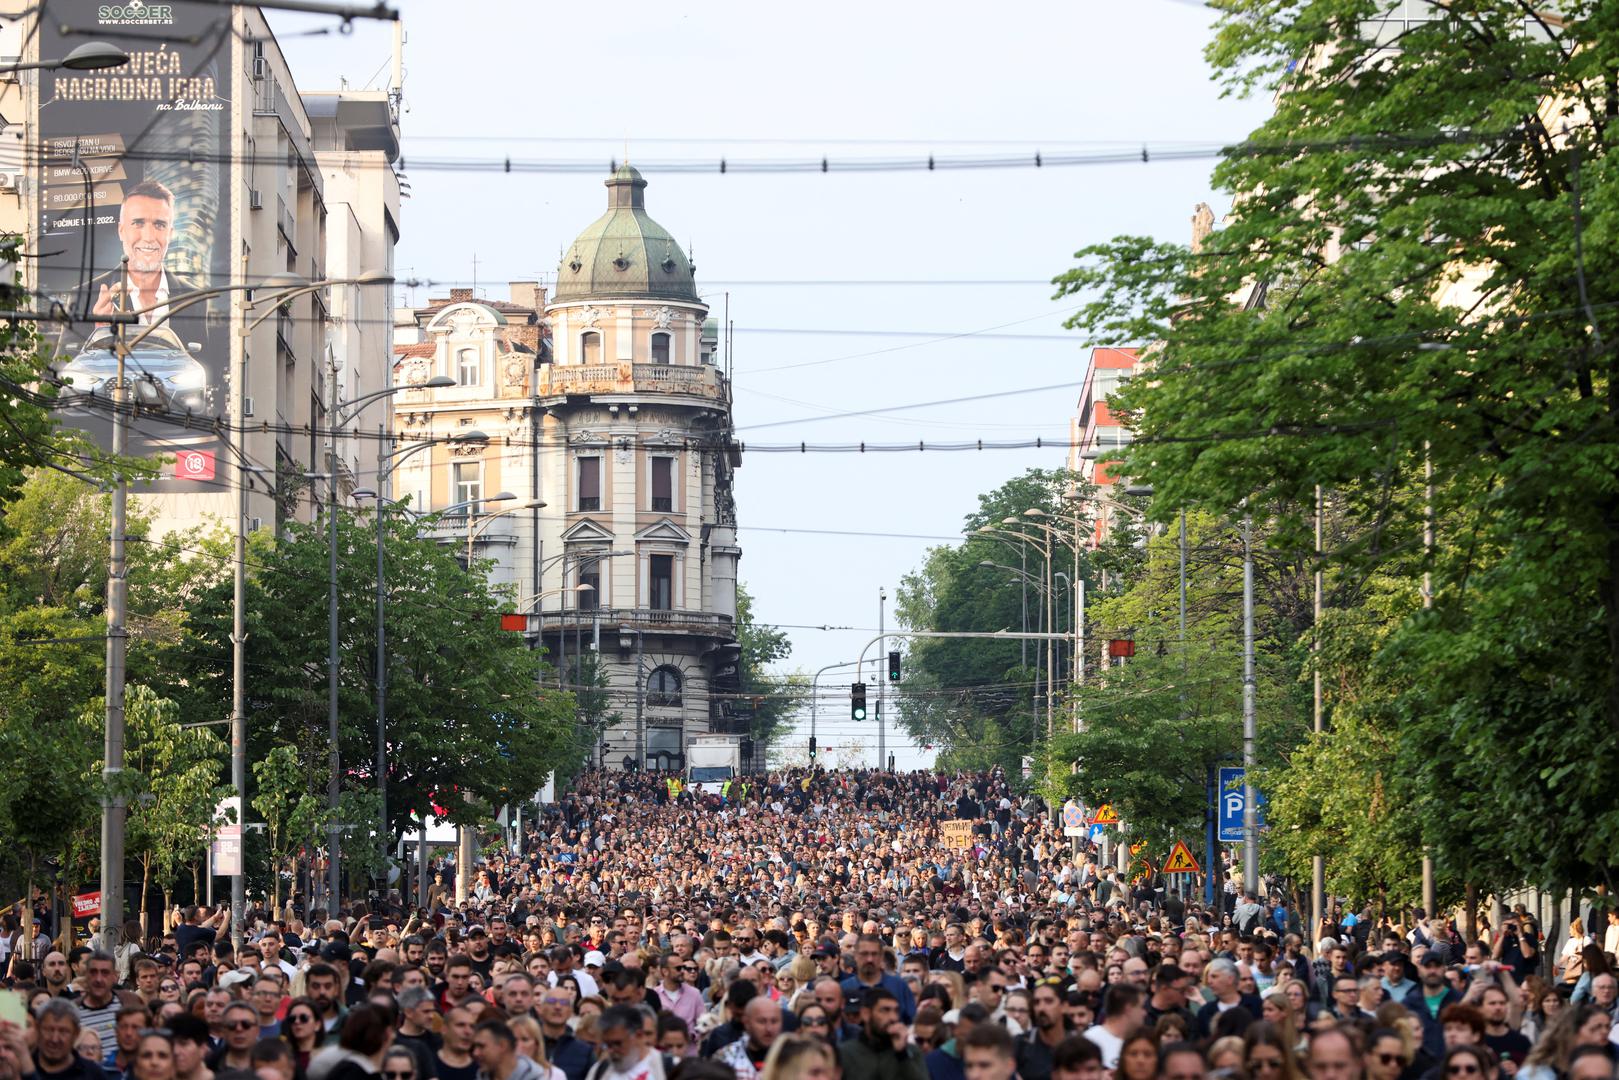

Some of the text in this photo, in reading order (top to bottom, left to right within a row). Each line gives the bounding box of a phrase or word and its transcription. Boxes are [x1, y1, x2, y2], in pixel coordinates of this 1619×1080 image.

[88, 43, 181, 75] JVEĆA
[54, 77, 216, 100] NAGRADNA IGRA
[156, 98, 224, 111] na Balkanu
[54, 168, 71, 177] BMW
[1227, 798, 1243, 819] P
